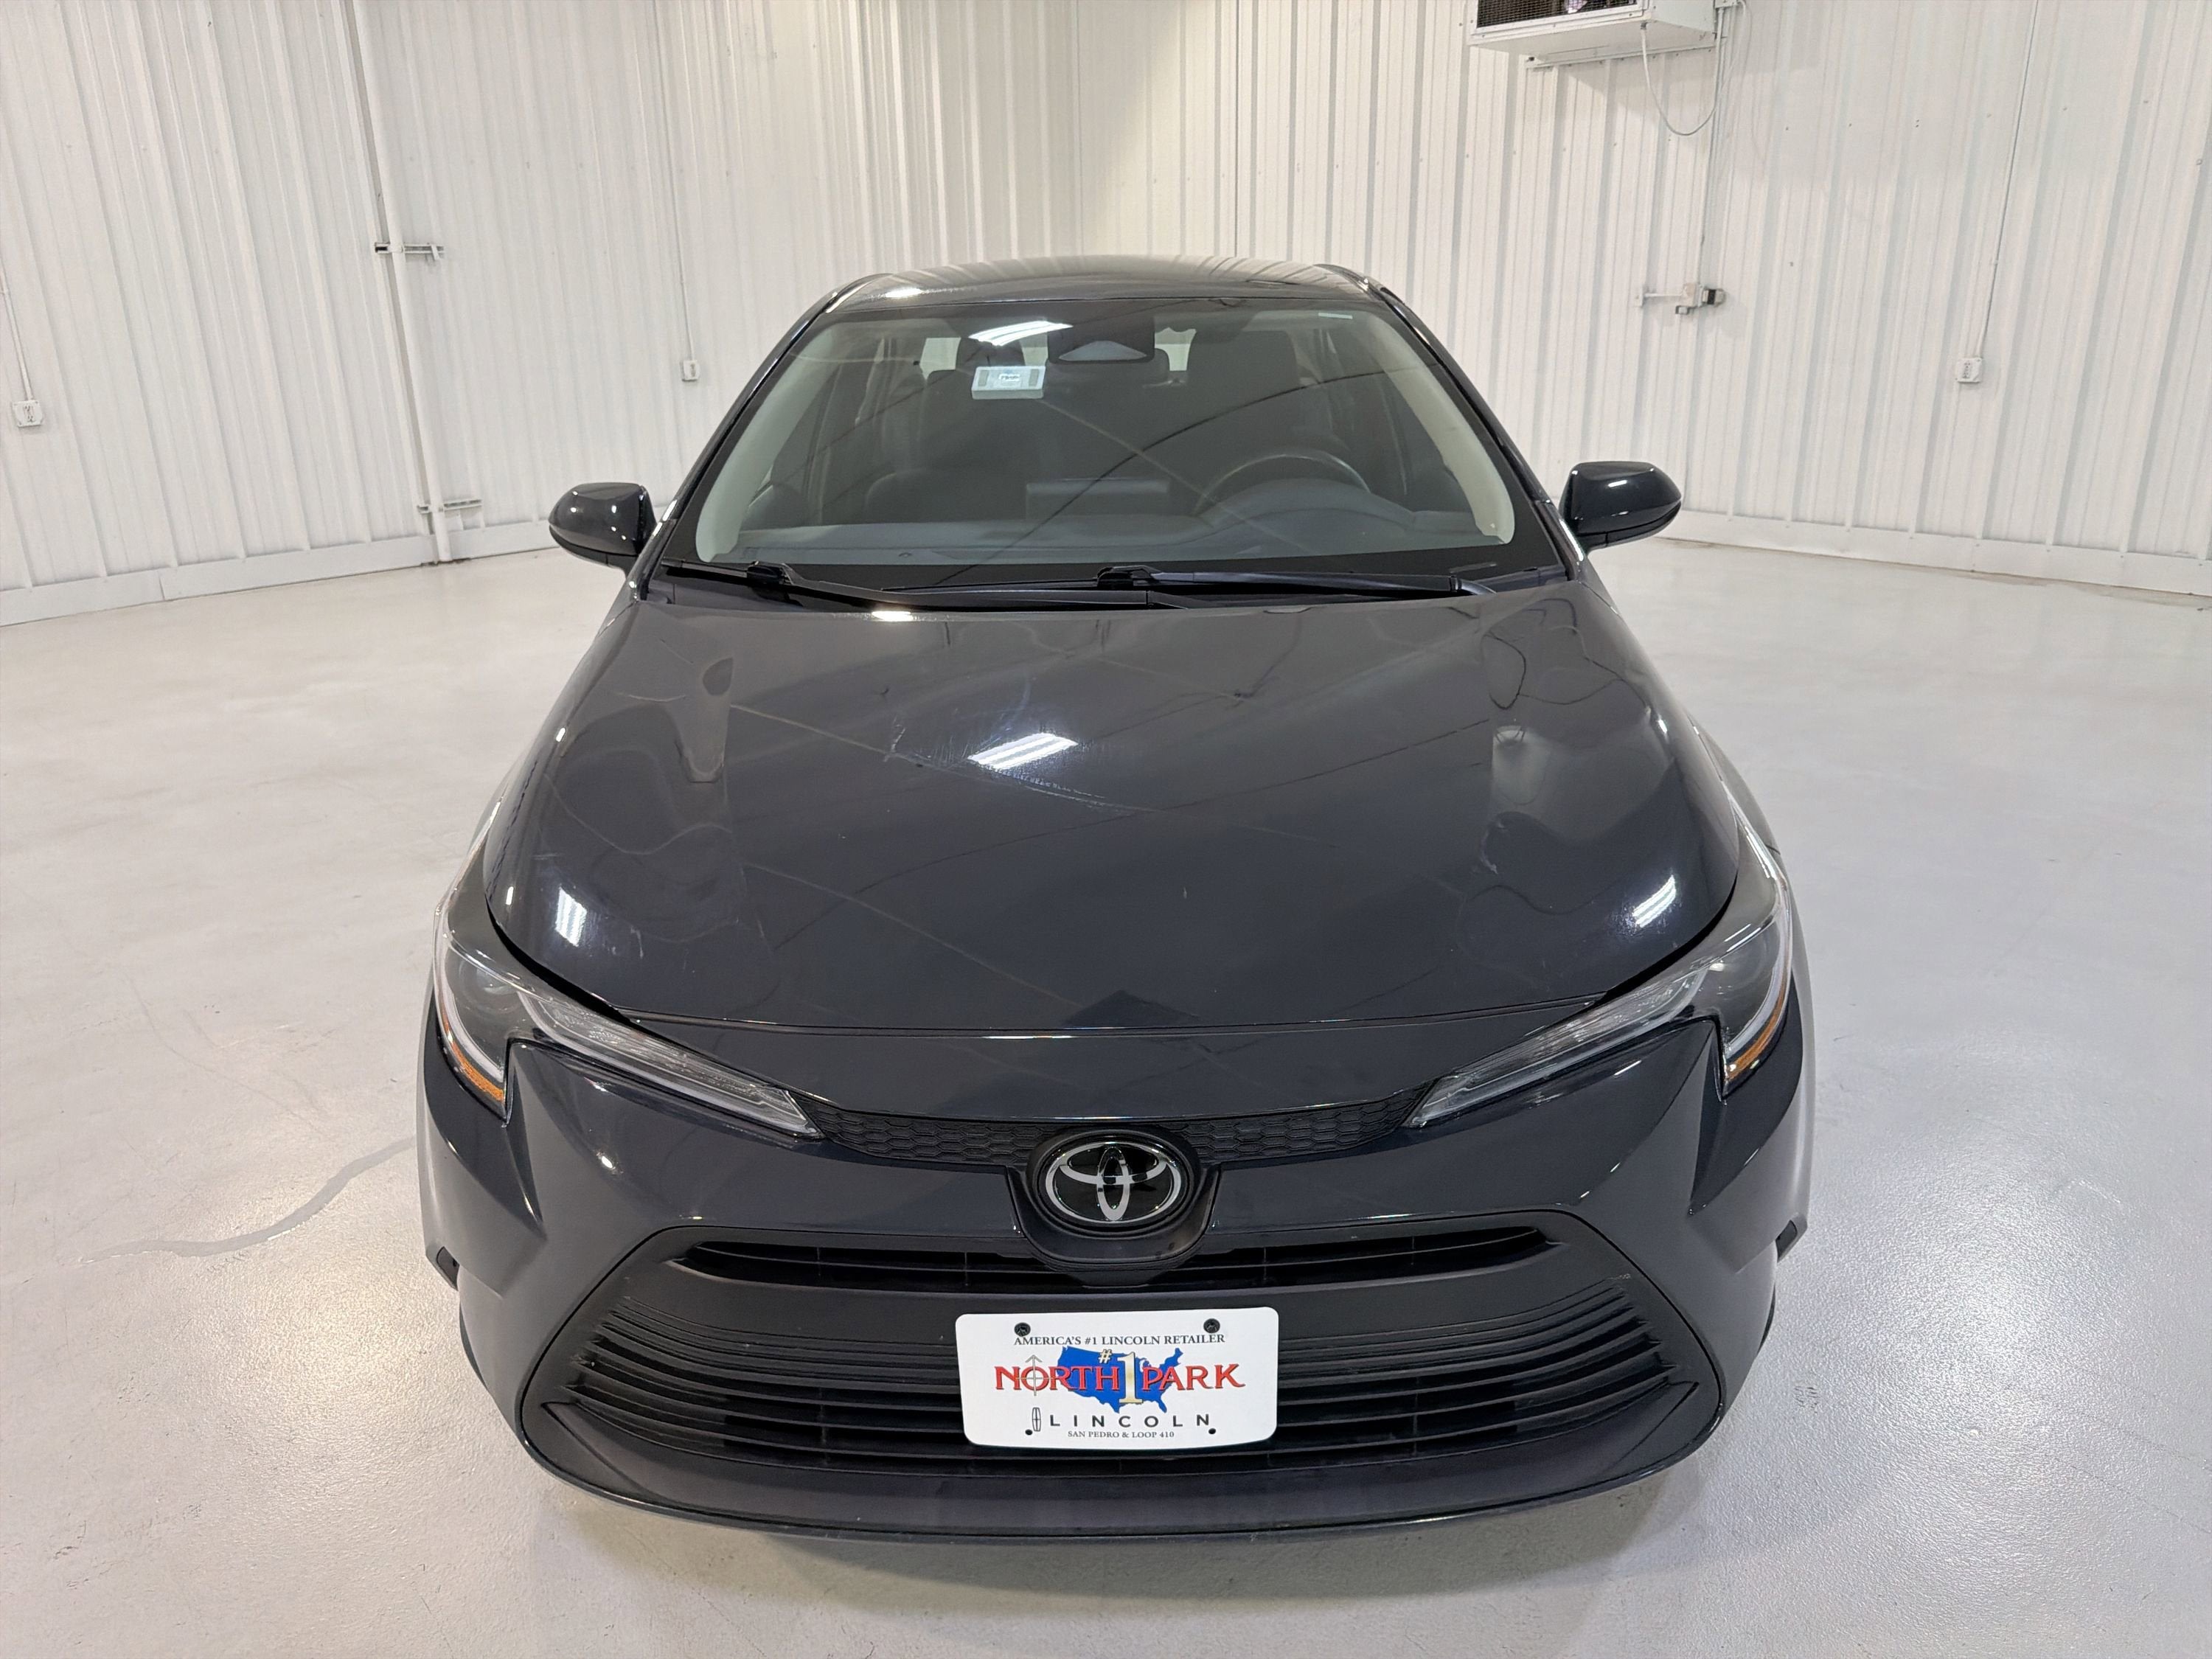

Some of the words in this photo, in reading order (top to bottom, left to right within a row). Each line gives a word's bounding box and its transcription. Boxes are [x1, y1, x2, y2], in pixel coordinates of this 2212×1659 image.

[1014, 1336, 1081, 1346] AMERICA'S
[1085, 1336, 1097, 1345] #1
[1102, 1335, 1160, 1345] LINCOLN
[1164, 1335, 1225, 1344] RETAILER
[995, 1366, 1119, 1391] NORTH
[1143, 1363, 1245, 1391] PARK
[1050, 1413, 1209, 1427] LINCOLN
